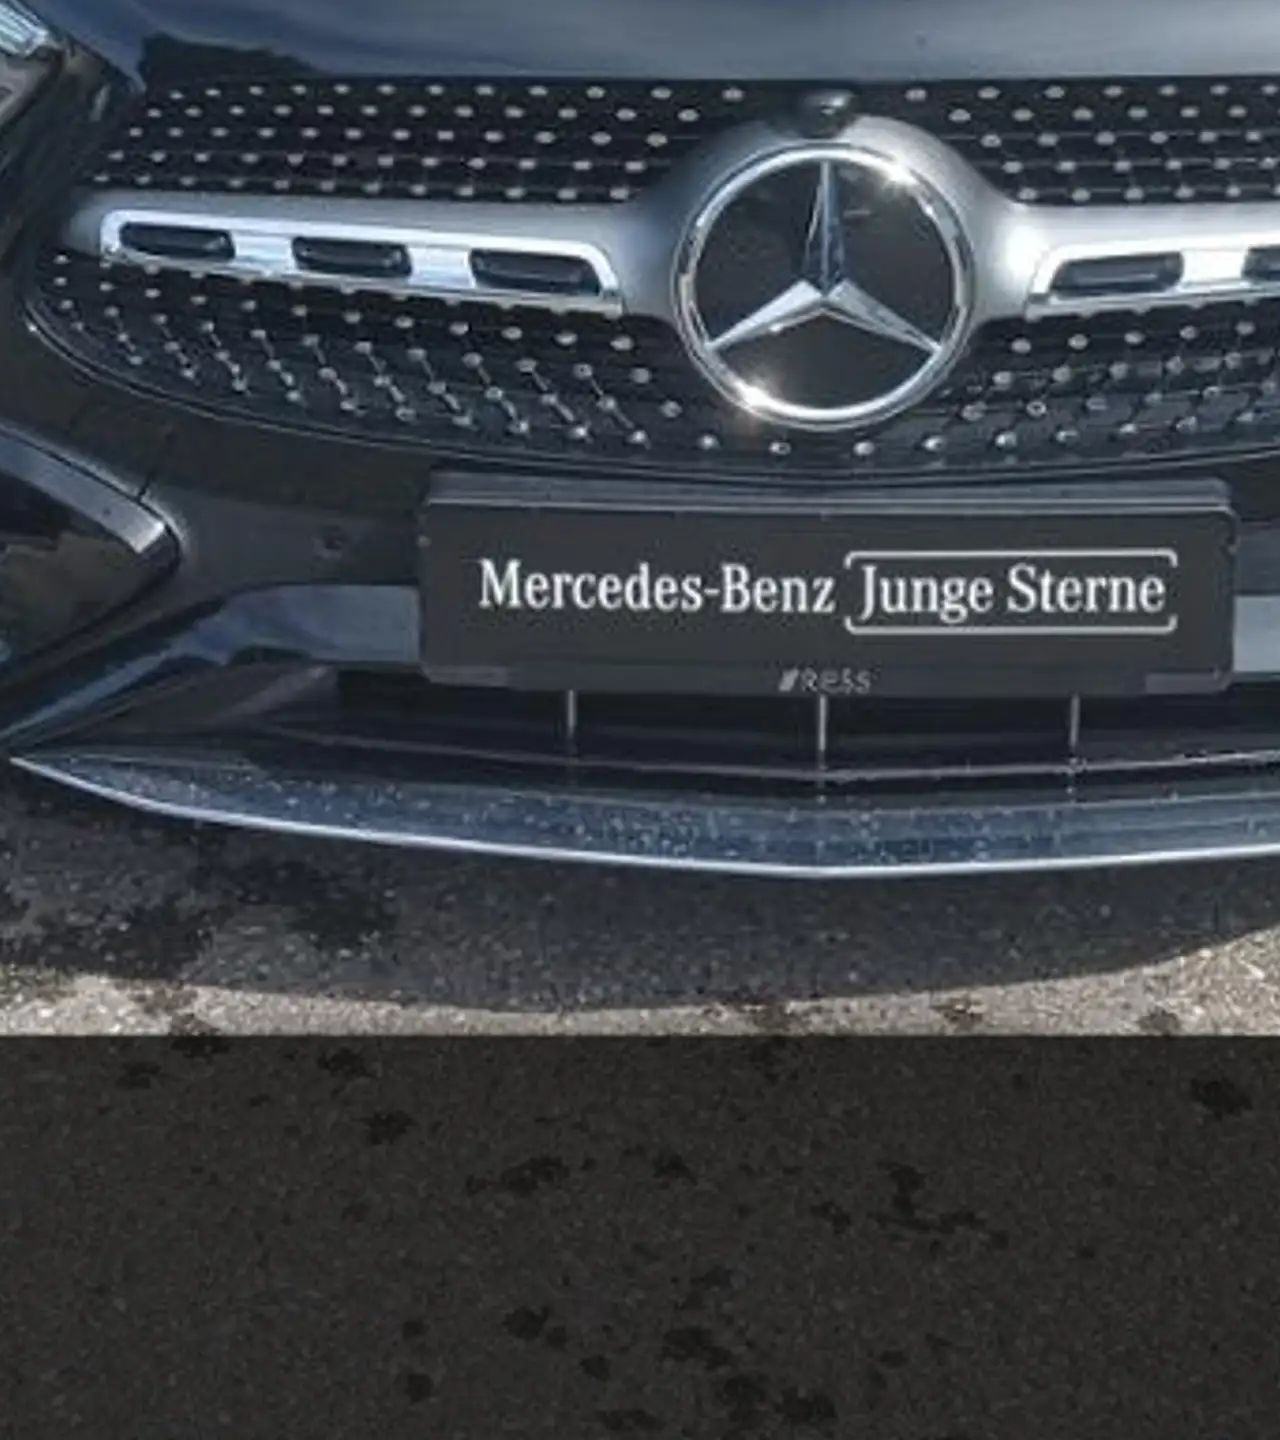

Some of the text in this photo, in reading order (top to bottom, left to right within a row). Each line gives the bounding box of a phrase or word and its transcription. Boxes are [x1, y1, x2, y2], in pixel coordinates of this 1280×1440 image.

[478, 556, 1166, 622] Mercedes-Benz Junge Sterne
